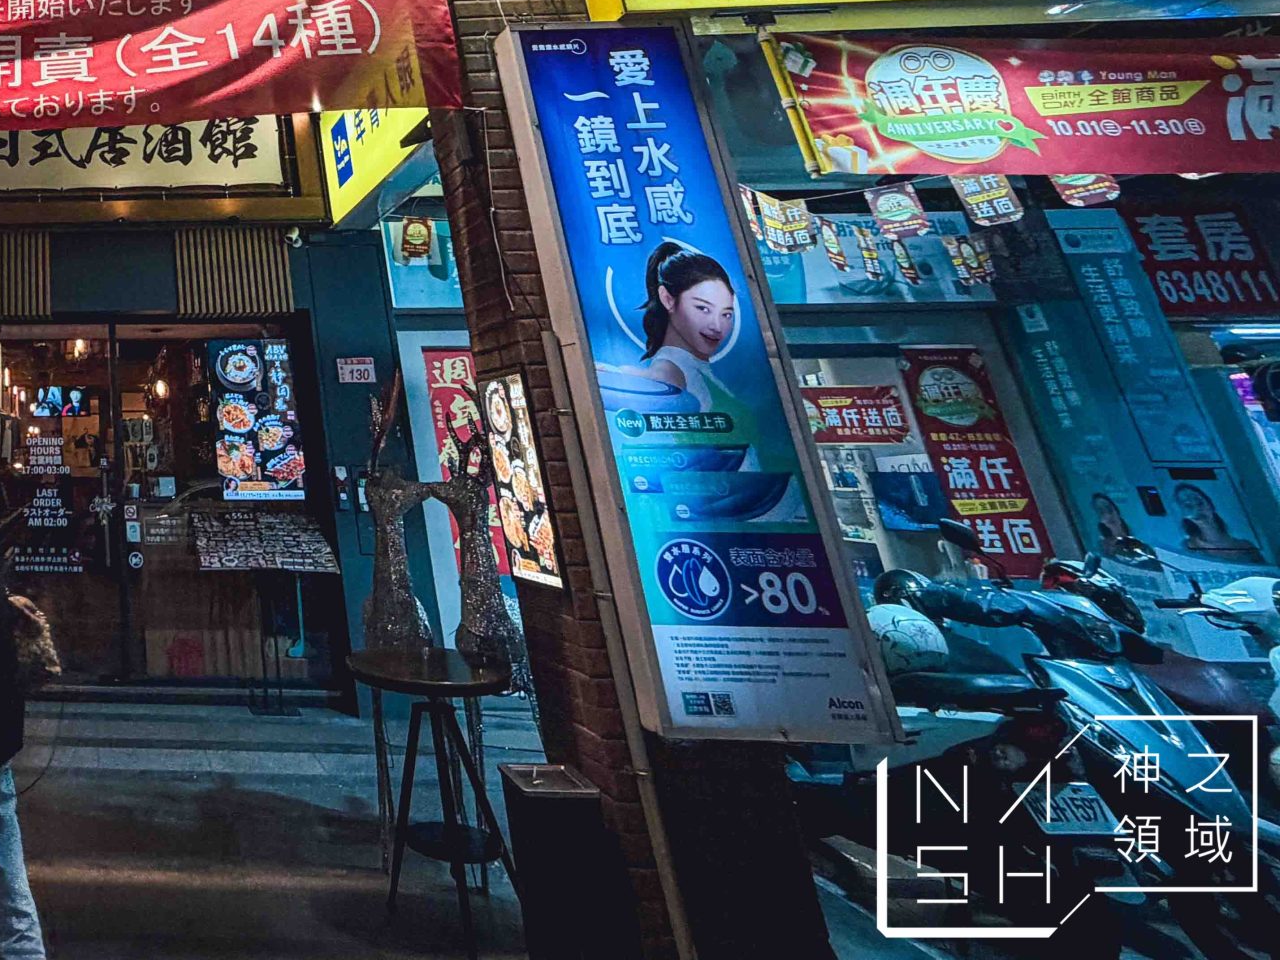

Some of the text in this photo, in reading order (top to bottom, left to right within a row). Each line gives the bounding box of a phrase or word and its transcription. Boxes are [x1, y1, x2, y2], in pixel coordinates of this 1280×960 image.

[1099, 69, 1178, 81] Young Man
[868, 76, 1005, 116] 週年慶
[1087, 85, 1181, 107] 全館商品
[885, 117, 997, 137] ANNIVERSARY
[608, 49, 694, 225] 愛上水感
[563, 91, 645, 245] 一鏡到底
[1135, 211, 1256, 262] 套房
[349, 369, 370, 381] 130
[617, 417, 643, 428] New
[650, 415, 726, 430] 散光全新上市
[26, 437, 64, 446] OPENING
[30, 446, 61, 455] HOURS
[940, 456, 1014, 490] 滿仟
[36, 488, 59, 497] LAST
[33, 498, 62, 507] ORDER
[22, 508, 73, 518] ラストオーダー
[28, 518, 68, 527] AM 02:00
[828, 696, 865, 710] Alcon
